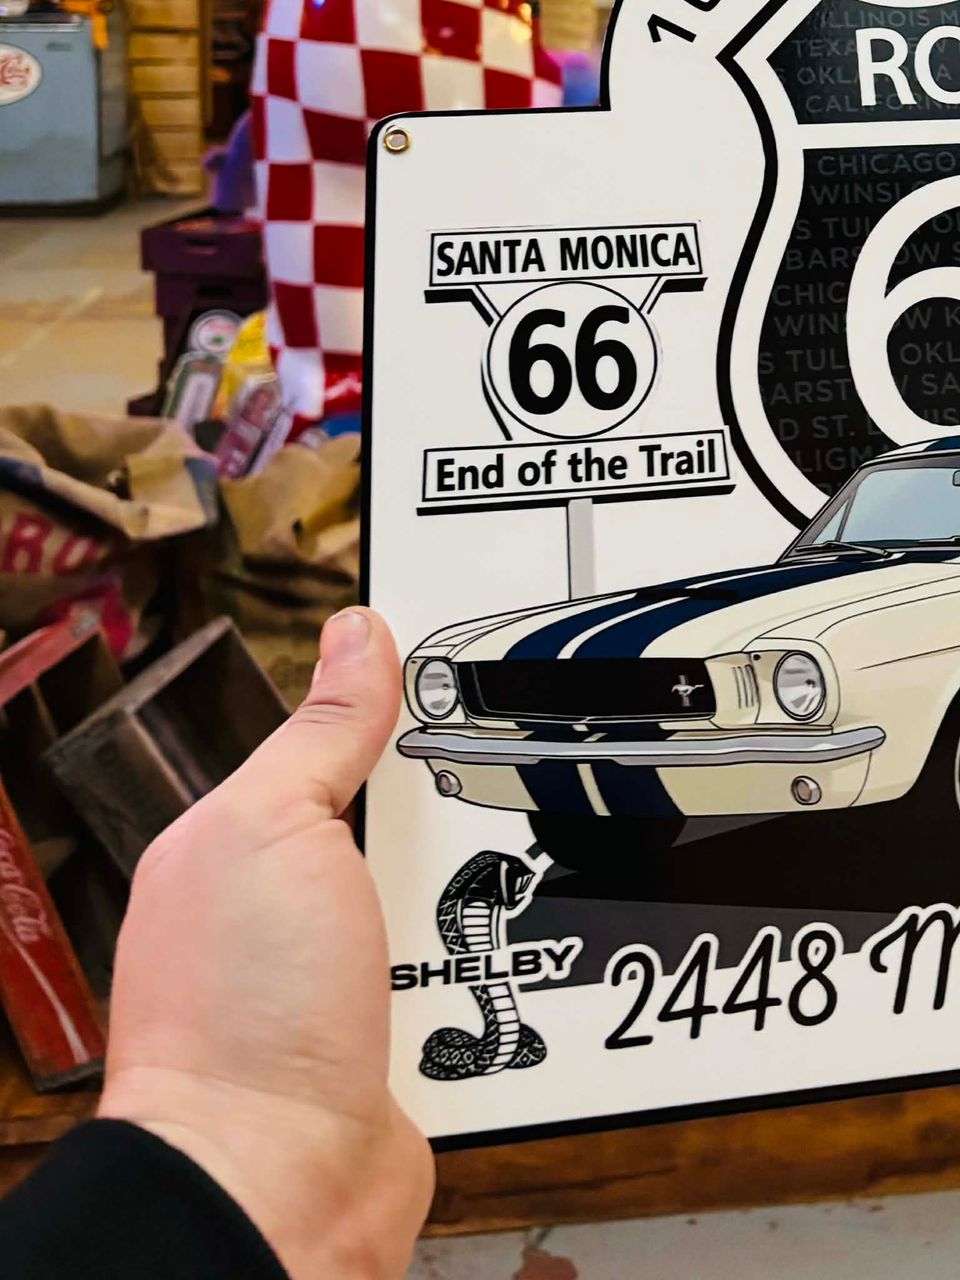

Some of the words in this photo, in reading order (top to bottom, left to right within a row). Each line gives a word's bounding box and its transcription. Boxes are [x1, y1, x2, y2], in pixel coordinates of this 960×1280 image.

[820, 8, 930, 29] ILLINOIS
[817, 150, 957, 176] CHICAGO
[436, 237, 546, 276] SANTA
[560, 232, 696, 272] MONICA
[508, 305, 637, 415] 66
[437, 453, 504, 492] End
[517, 450, 557, 486] of
[567, 447, 628, 483] the
[638, 438, 716, 478] Trail
[391, 943, 577, 992] SHELBY
[604, 929, 838, 1050] 2448
